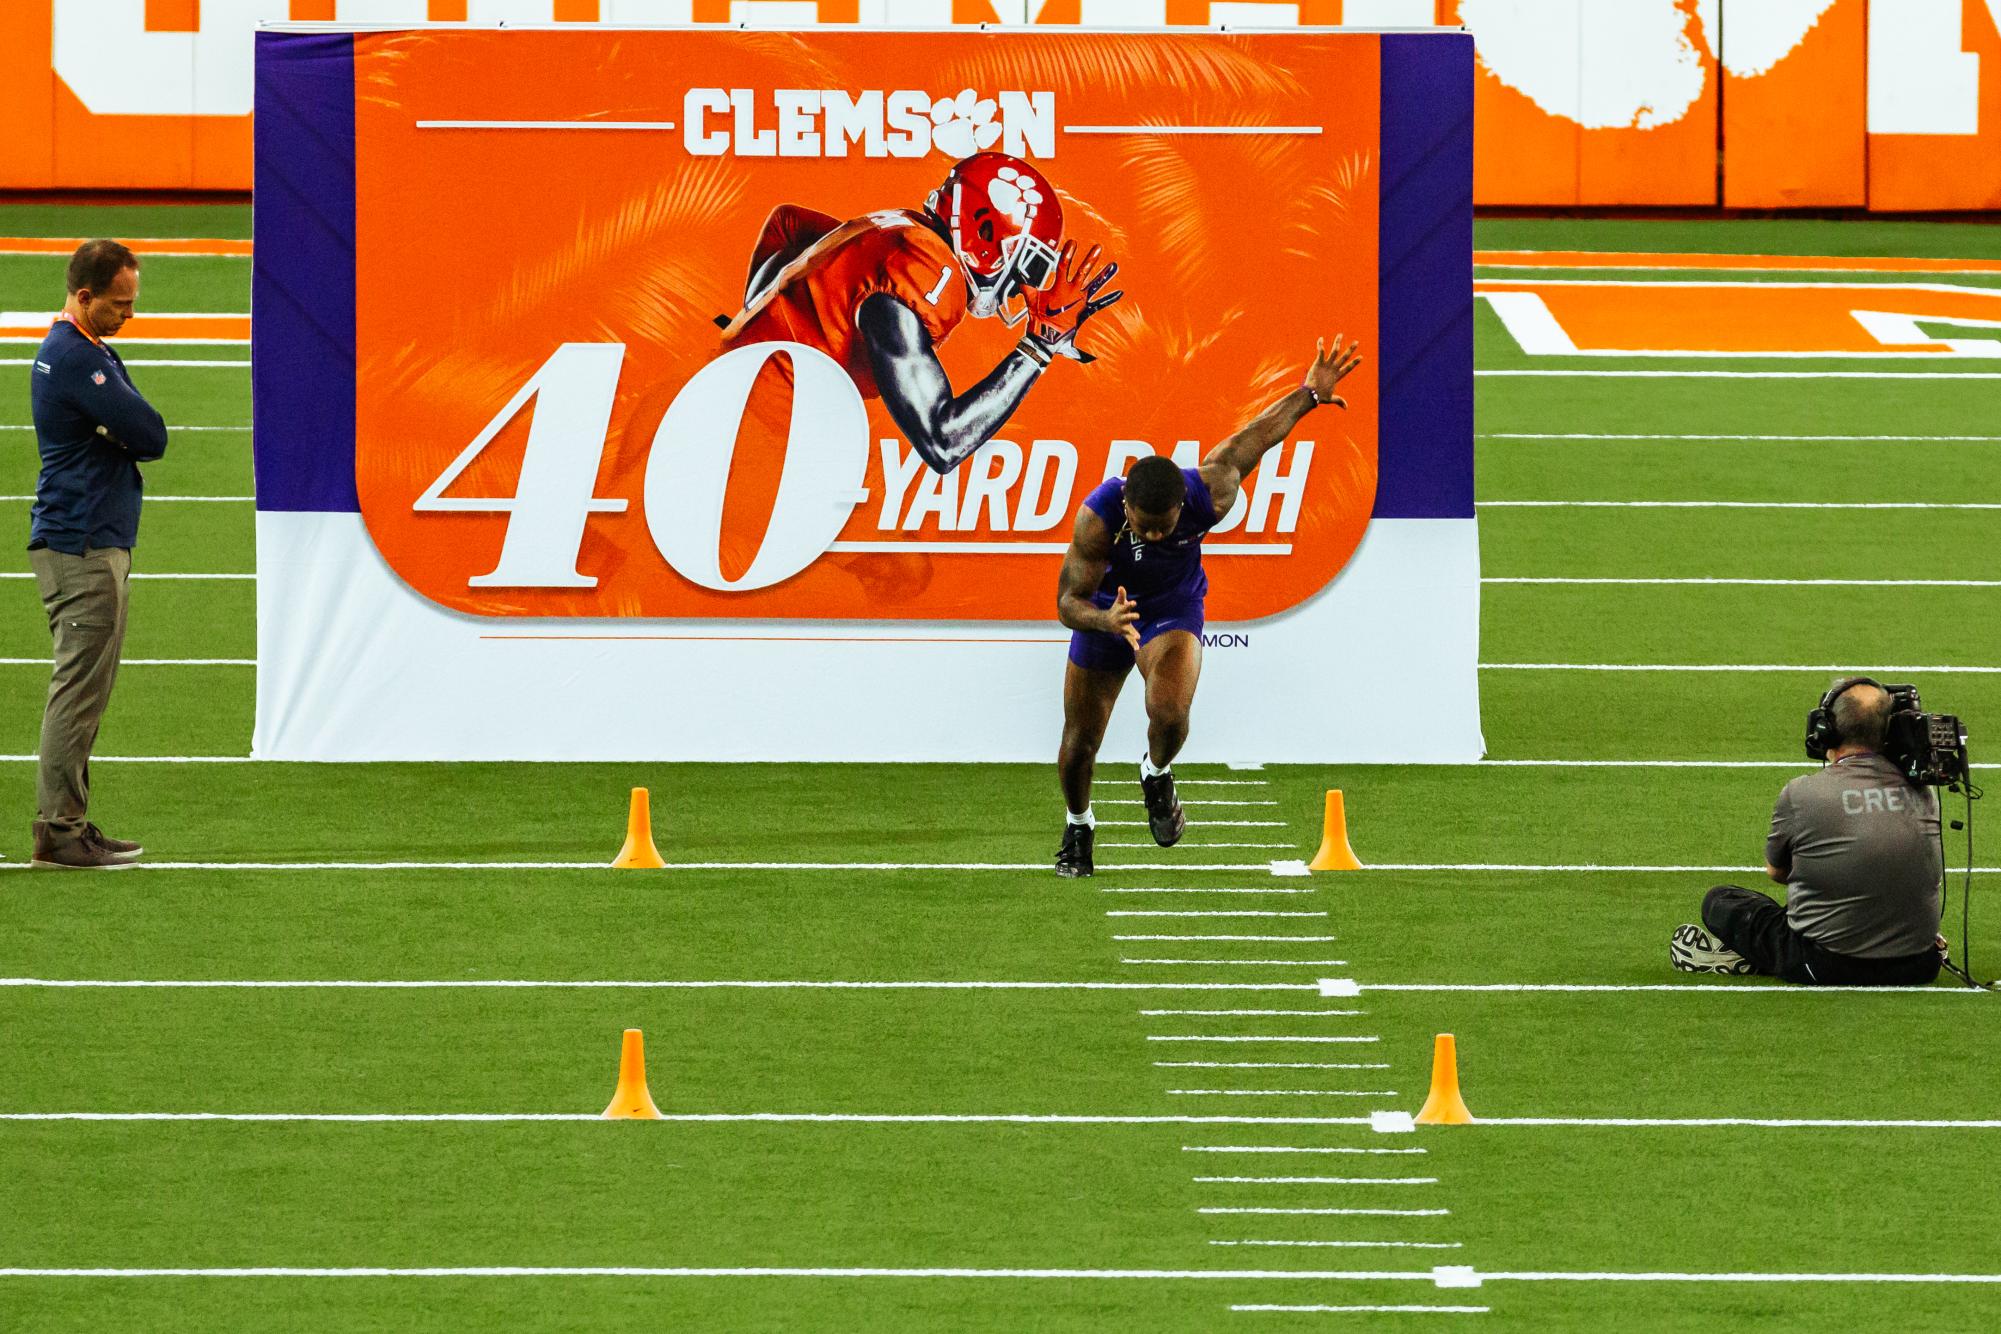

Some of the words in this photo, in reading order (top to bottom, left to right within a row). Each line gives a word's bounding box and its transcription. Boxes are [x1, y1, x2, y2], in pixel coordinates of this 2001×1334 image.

[924, 265, 953, 306] 1
[413, 341, 869, 592] 40
[878, 439, 1078, 532] YARD
[1102, 440, 1315, 534] DH
[1134, 549, 1143, 562] 6
